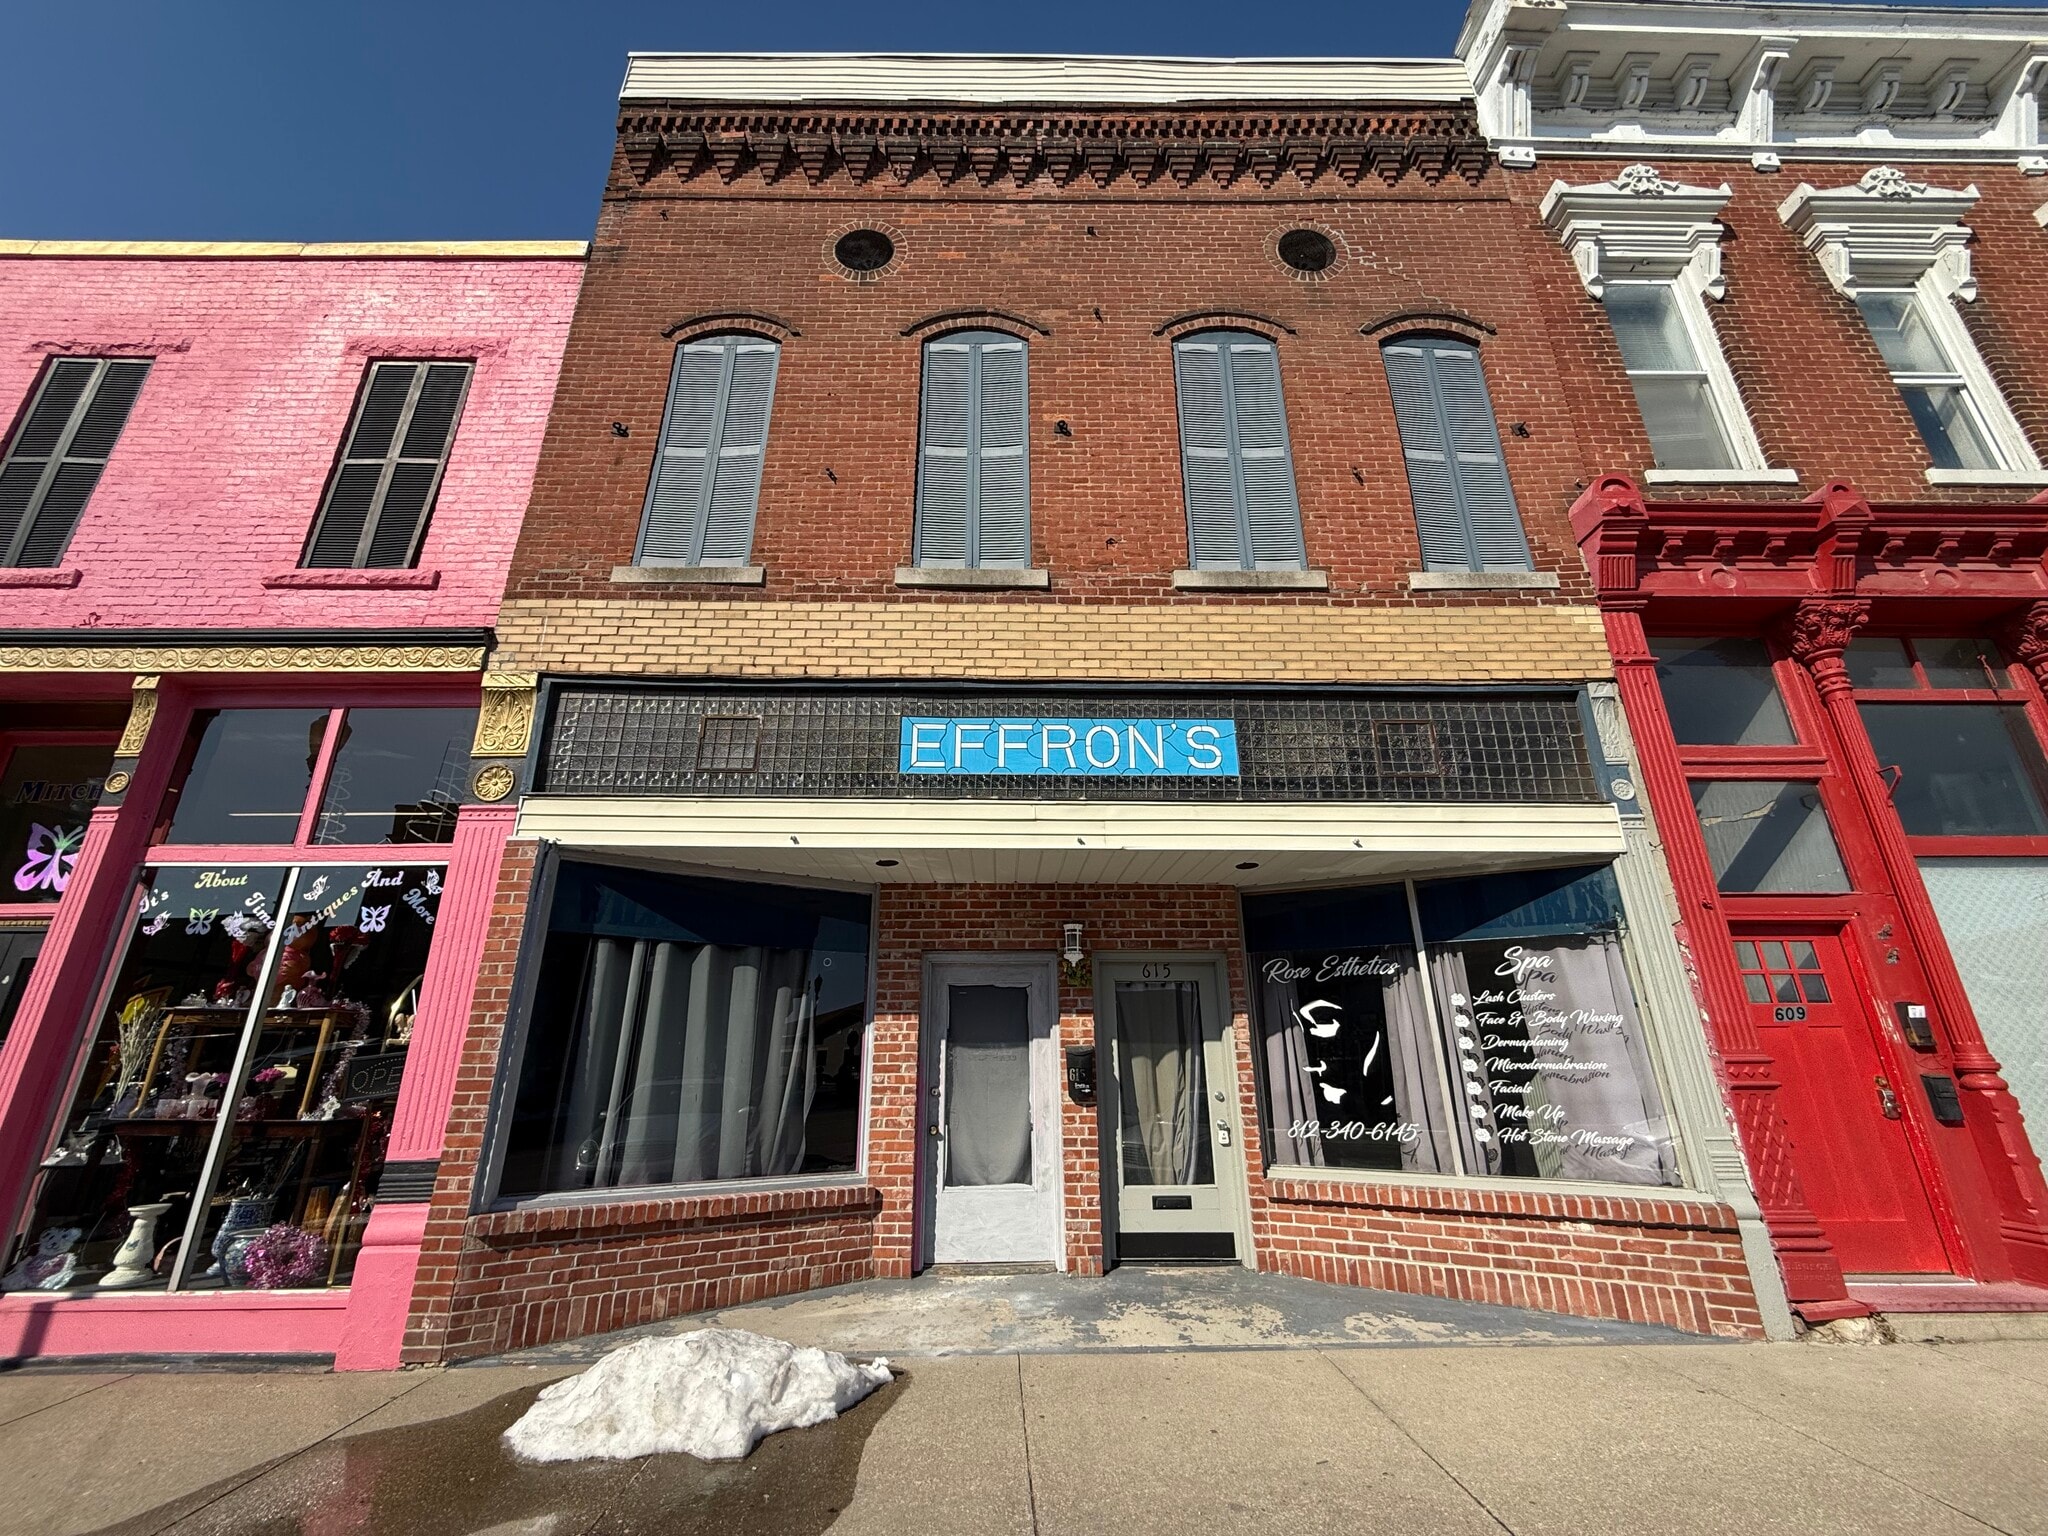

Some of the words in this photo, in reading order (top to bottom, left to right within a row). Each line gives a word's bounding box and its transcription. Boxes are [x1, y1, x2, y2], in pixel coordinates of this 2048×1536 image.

[911, 723, 1223, 769] EFFRON'S
[140, 888, 169, 914] It's
[194, 869, 248, 889] About
[244, 892, 277, 930] Time
[282, 886, 359, 945] Antiques
[361, 868, 405, 888] And
[402, 888, 435, 925] More
[1142, 962, 1171, 979] 615
[1262, 958, 1312, 984] Rose
[1315, 955, 1401, 983] Esthetics
[1494, 945, 1554, 983] Spa
[1472, 989, 1505, 1006] Lash
[1506, 989, 1557, 1005] Clusters
[1476, 1011, 1506, 1027] Face
[1528, 1010, 1569, 1029] Body
[1570, 1009, 1624, 1029] Waxing
[1775, 1006, 1806, 1021] 609
[1480, 1034, 1570, 1053] Dermaplaning
[1069, 1067, 1086, 1082] 615
[1484, 1056, 1609, 1073] Microdermabrasion
[351, 1066, 404, 1091] OPE
[1488, 1079, 1534, 1096] Facials
[1493, 1103, 1535, 1121] Make
[1536, 1104, 1566, 1125] Up
[1287, 1119, 1421, 1142] 812-340-6145
[1497, 1127, 1530, 1144] Hot
[1529, 1128, 1569, 1145] Stone
[1570, 1128, 1636, 1151] Massage
